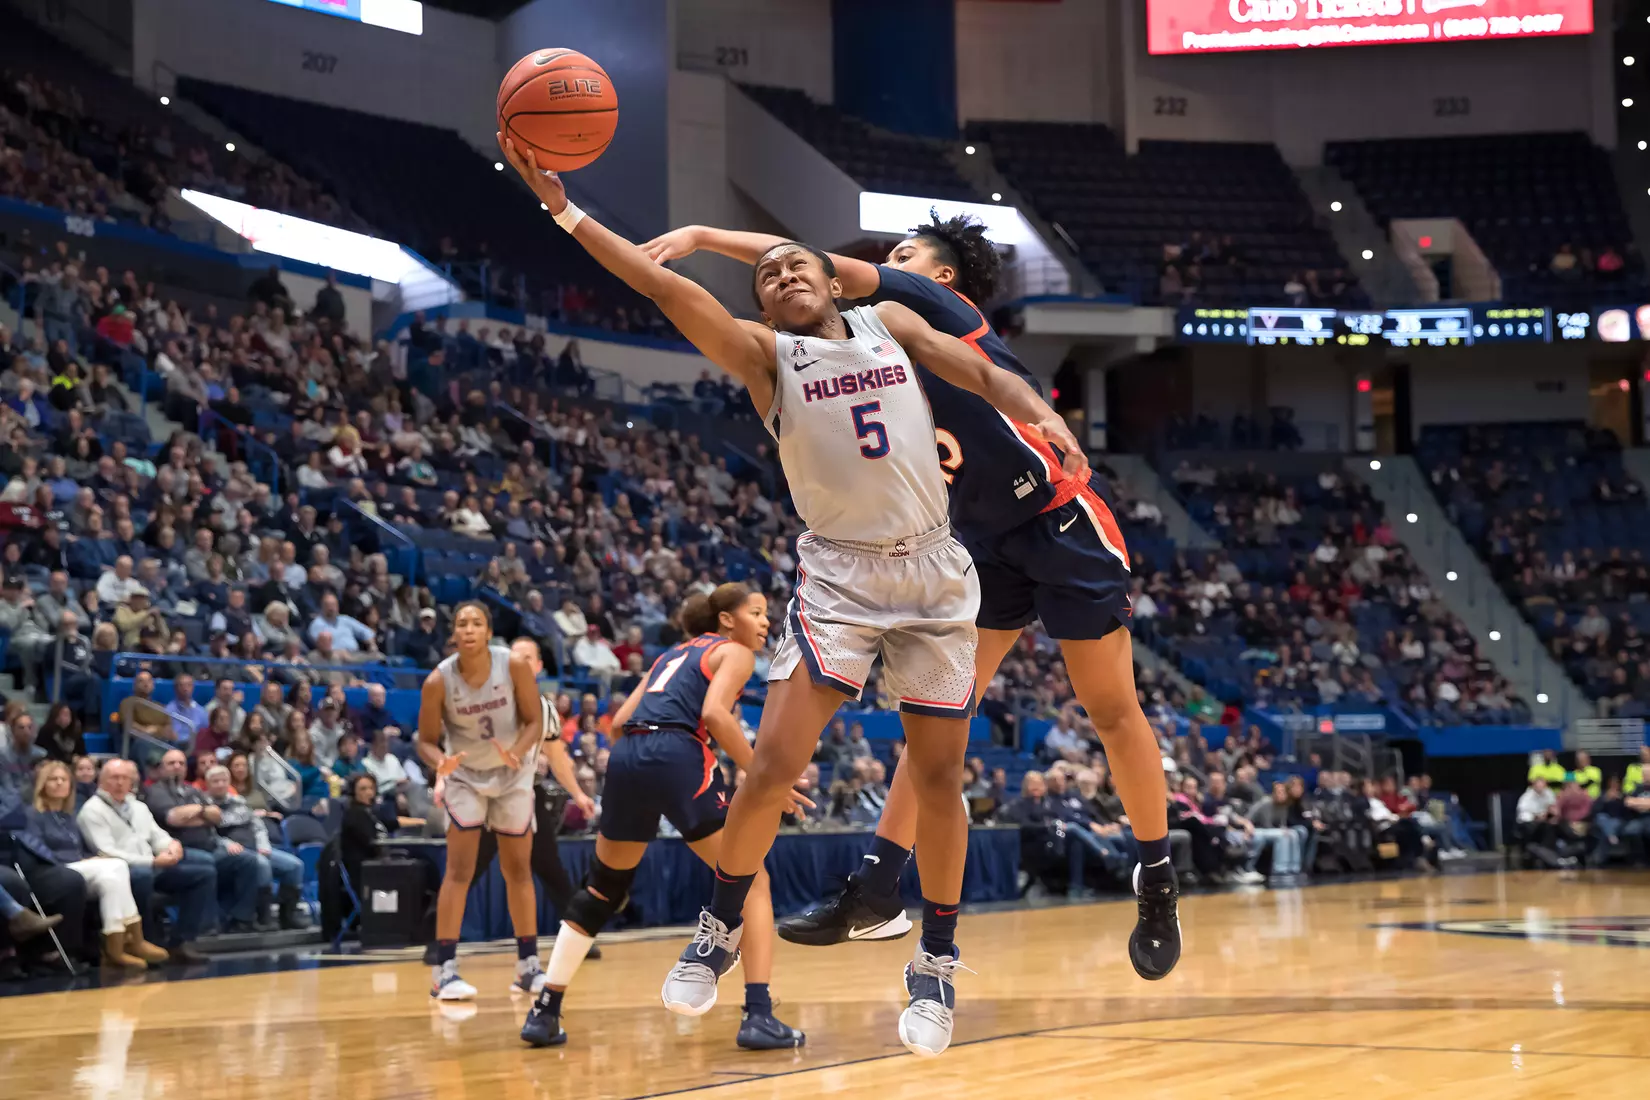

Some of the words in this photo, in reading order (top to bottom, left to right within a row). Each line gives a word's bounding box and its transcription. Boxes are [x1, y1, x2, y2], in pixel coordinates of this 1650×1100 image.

[301, 51, 339, 75] 207
[716, 46, 748, 66] 231
[548, 78, 602, 96] ELITE
[1153, 96, 1188, 117] 232
[802, 364, 908, 403] HUSKIES
[849, 400, 891, 460] 5
[888, 550, 910, 558] UCONN
[646, 651, 689, 693] 1
[456, 696, 508, 716] HUSKIES
[478, 715, 495, 740] 3
